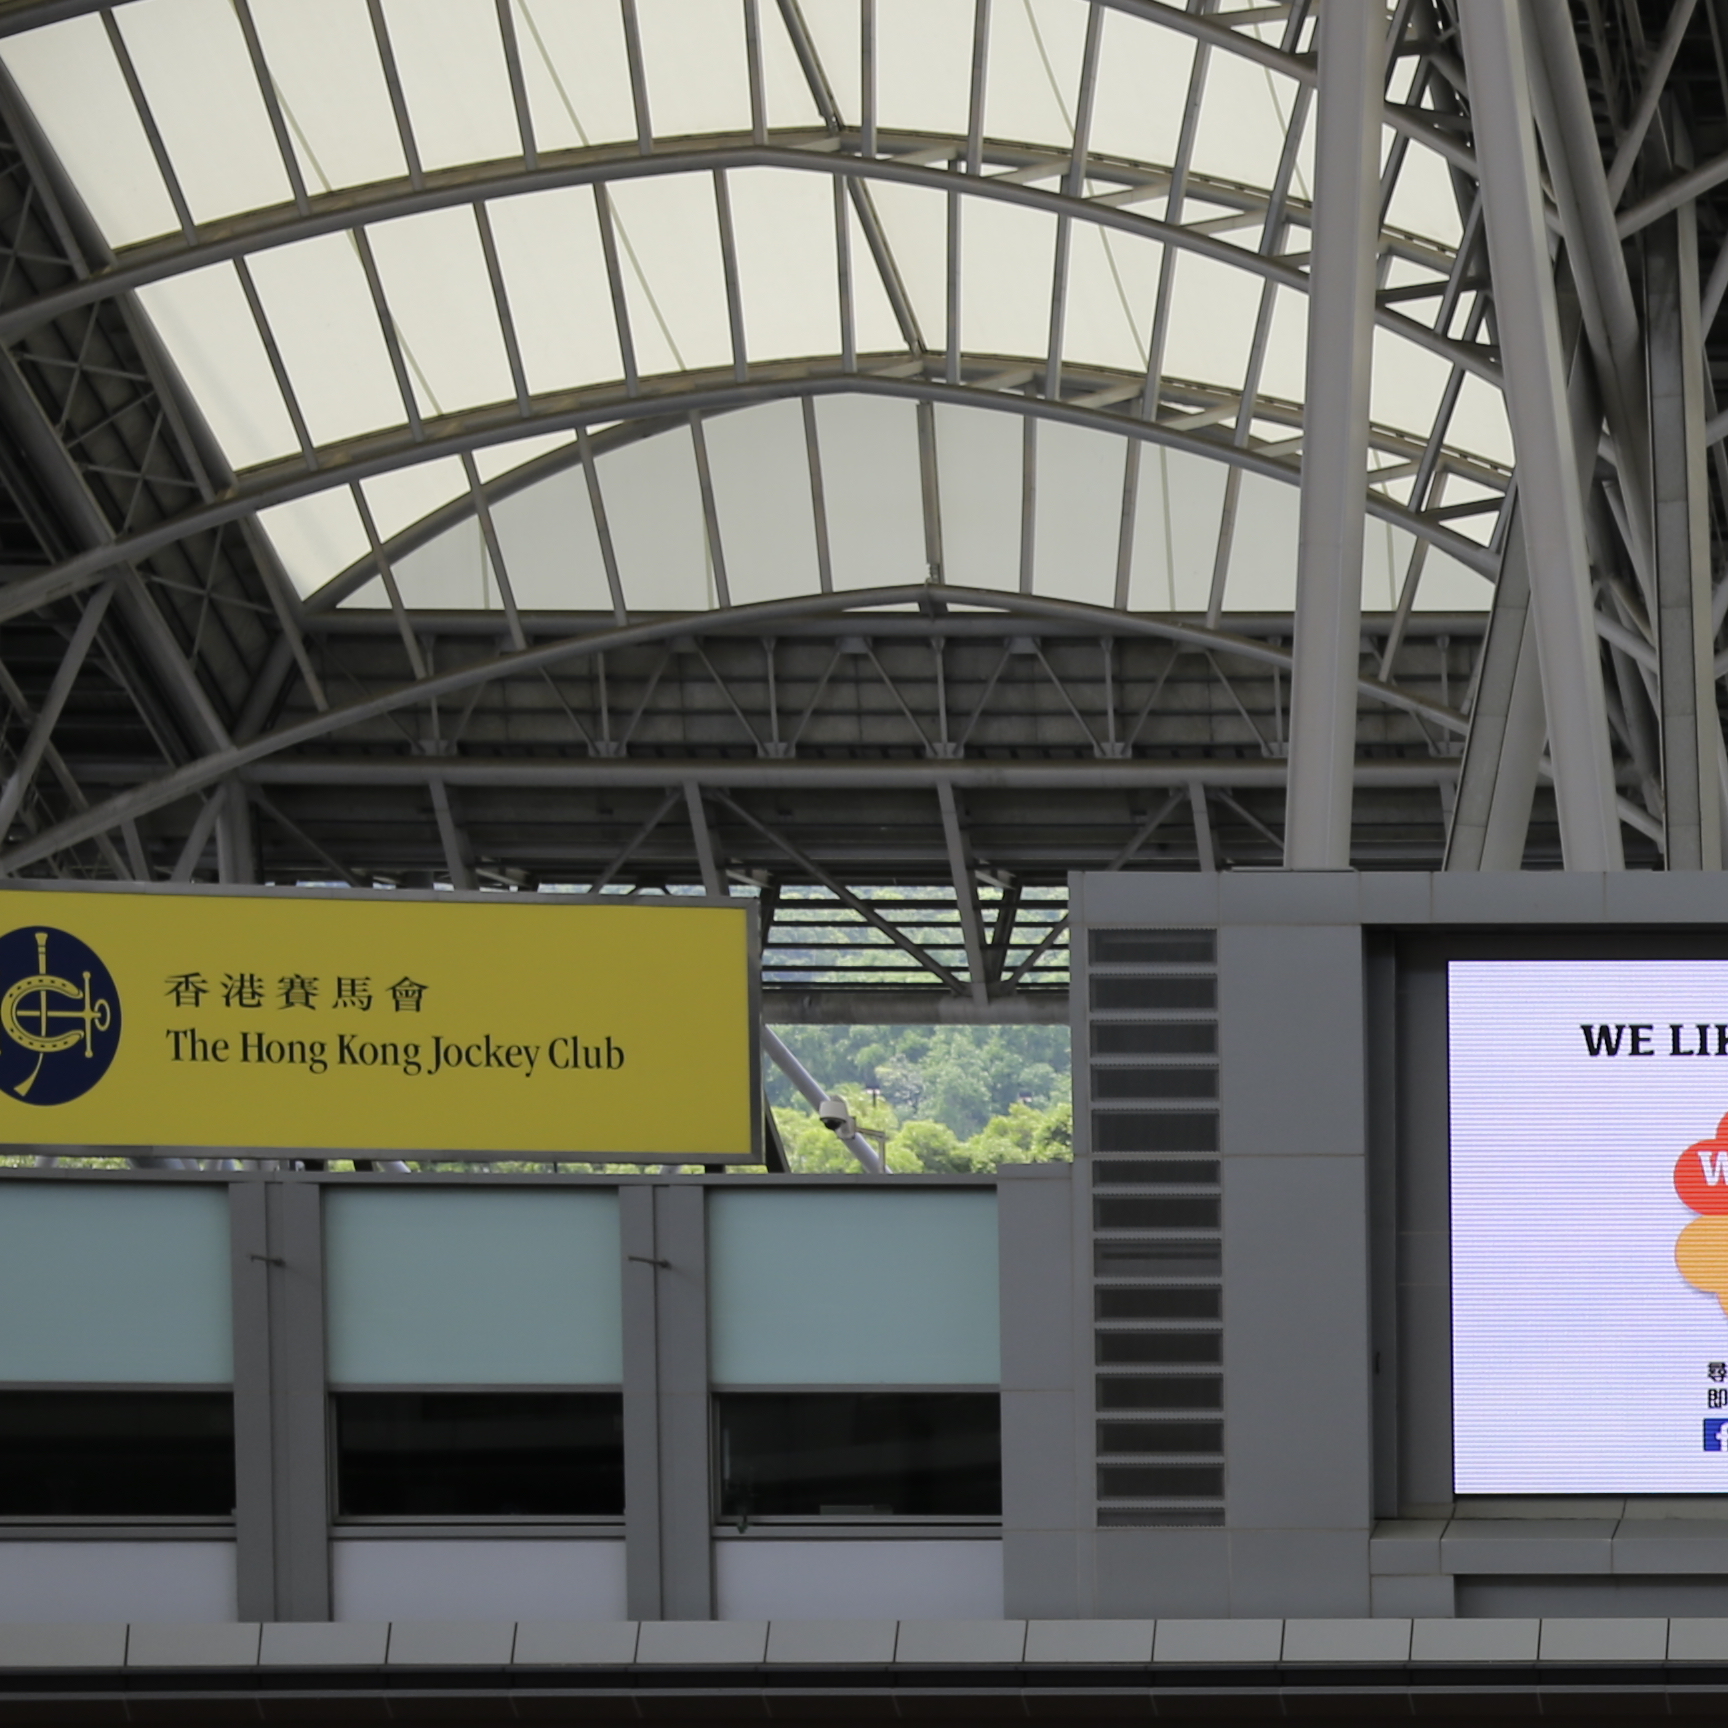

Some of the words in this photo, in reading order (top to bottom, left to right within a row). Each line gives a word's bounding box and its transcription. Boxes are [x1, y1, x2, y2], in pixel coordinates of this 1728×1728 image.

[165, 970, 430, 1014] 香港賽馬會
[165, 1027, 230, 1063] The
[240, 1031, 329, 1074] Hong
[337, 1034, 422, 1076] Kong
[427, 1034, 541, 1078] Jockey
[548, 1035, 626, 1070] Club
[1580, 1024, 1655, 1057] WE
